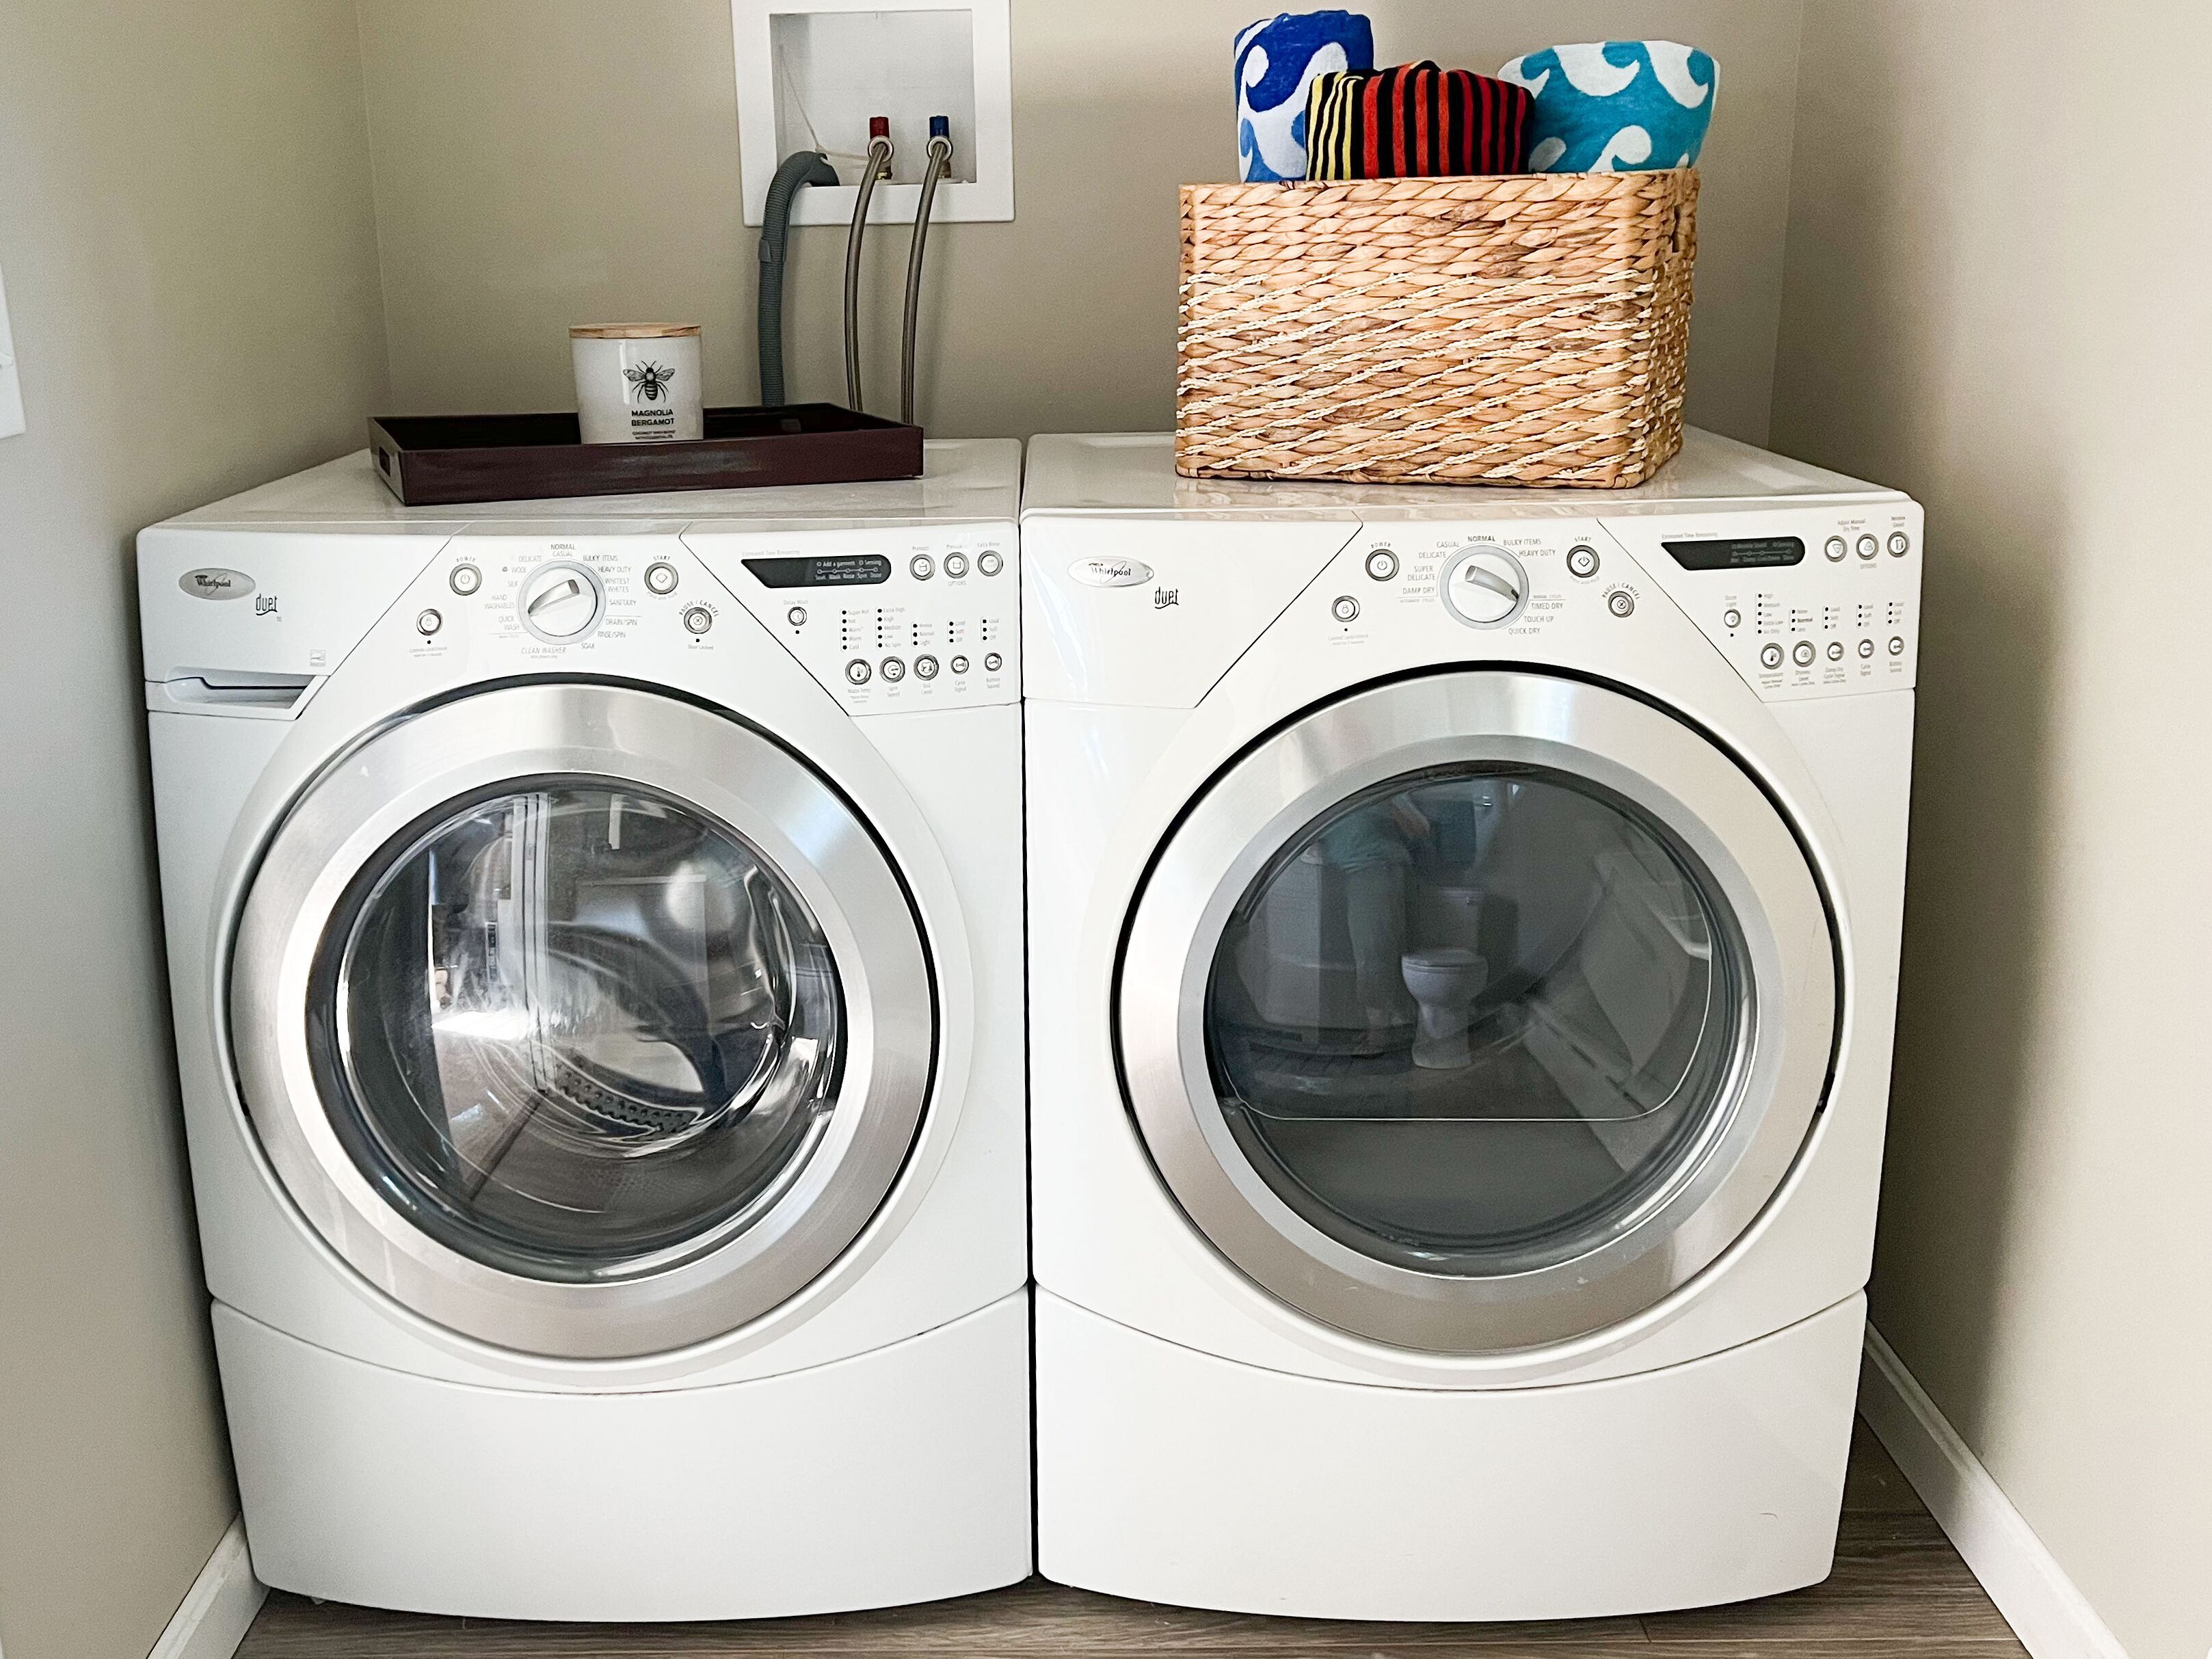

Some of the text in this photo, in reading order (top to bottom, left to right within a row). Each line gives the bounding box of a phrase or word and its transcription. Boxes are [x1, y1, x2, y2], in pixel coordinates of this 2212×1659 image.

[632, 418, 674, 426] BERGAMOT
[1089, 563, 1132, 577] Whirlpool
[195, 573, 231, 589] Whirlpool
[1155, 587, 1179, 609] duet
[1602, 583, 1640, 600] PAUSE CANCEL
[256, 593, 278, 615] duet
[679, 600, 719, 617] PAUSE CANCEL
